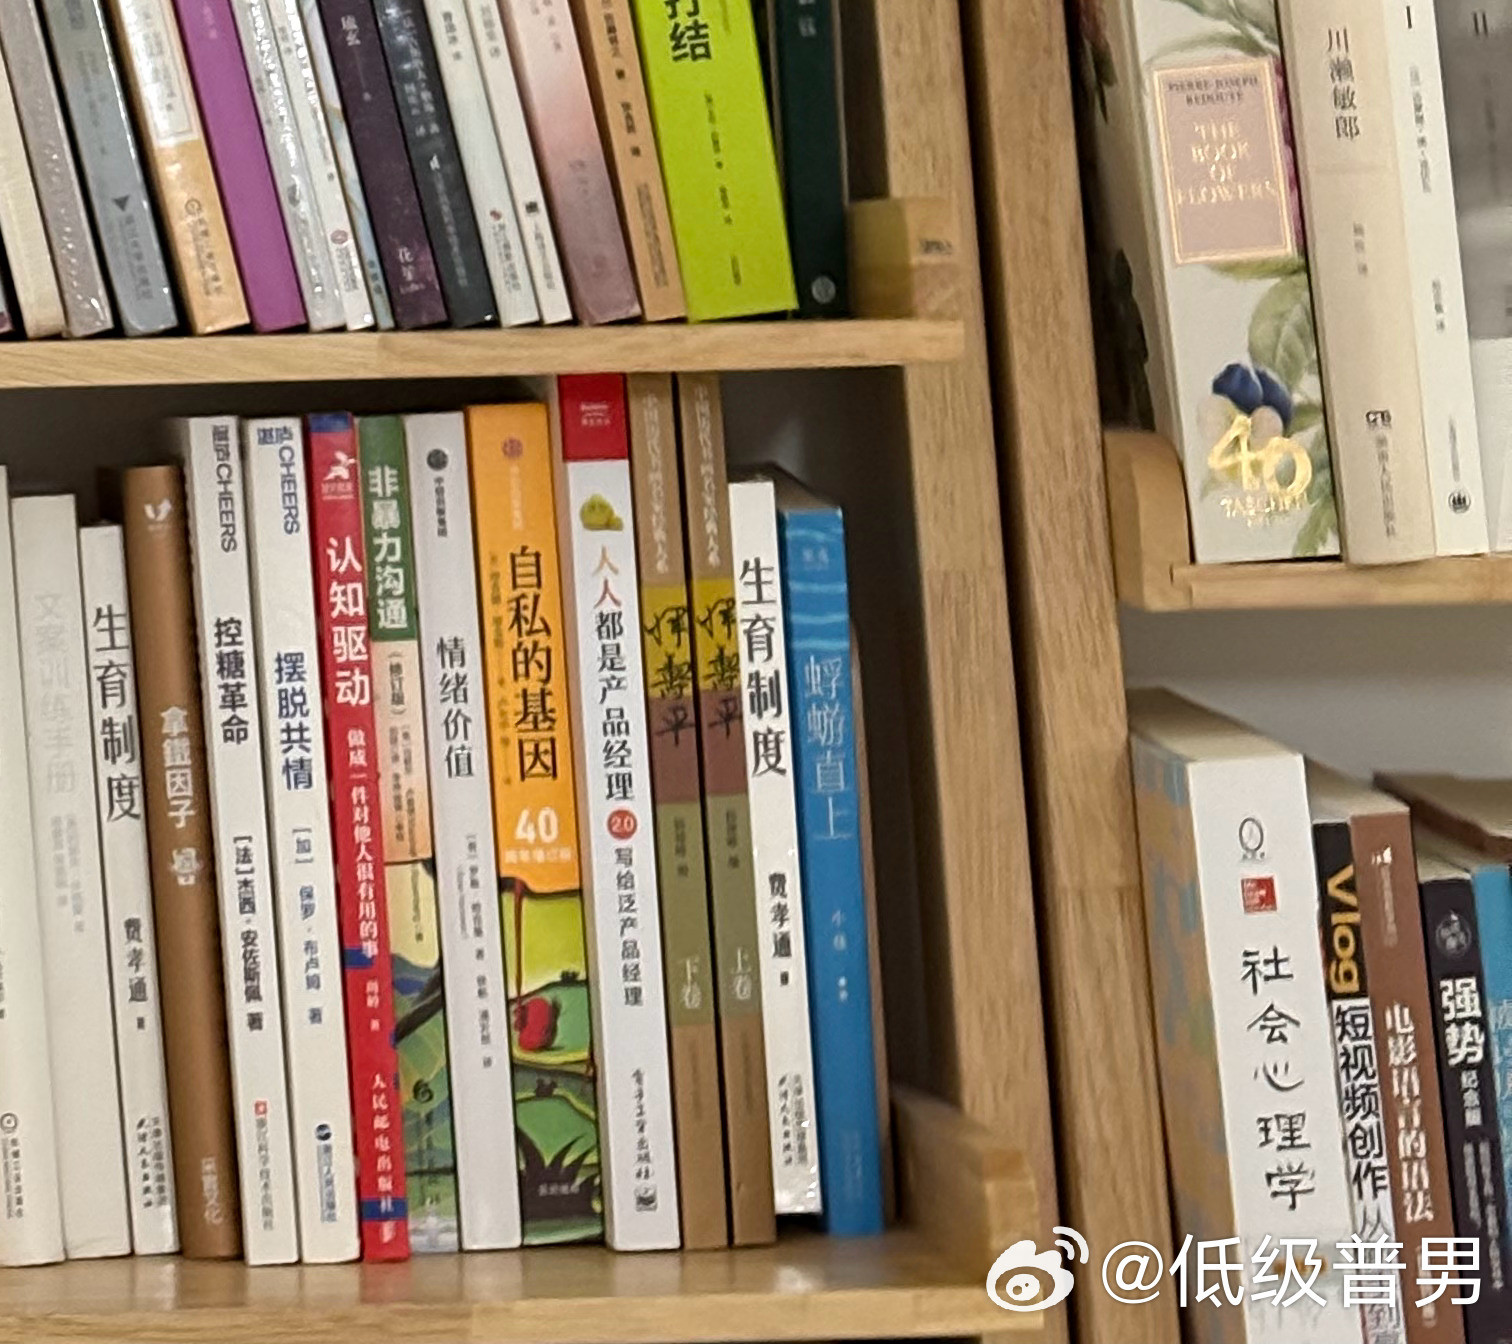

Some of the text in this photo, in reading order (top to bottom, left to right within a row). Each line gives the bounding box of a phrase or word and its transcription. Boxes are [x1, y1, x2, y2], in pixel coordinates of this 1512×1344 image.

[1194, 120, 1239, 141] THE
[1326, 27, 1362, 141] 川濑敏郎
[1176, 180, 1276, 206] FLOWERS
[1191, 141, 1250, 163] BOOK
[215, 463, 238, 553] CHEERS
[277, 446, 300, 536] CHEERS
[1207, 413, 1313, 500] 40
[367, 465, 409, 630] 非暴力沟通
[213, 616, 250, 746] 控糖革命
[326, 536, 371, 706] 认知驱动
[507, 545, 559, 783] 自私的基因
[593, 545, 636, 802] 人人都是产品经理
[739, 556, 787, 778] 生育制度
[33, 593, 79, 796] 文案训练手册
[91, 604, 142, 824] 生育制度
[274, 650, 314, 792] 摆脱共情
[436, 635, 475, 780] 情绪价值
[346, 728, 380, 959] 做成一件对他人很有用的事
[514, 807, 560, 843] 40
[123, 916, 149, 1004] 费孝通
[613, 846, 644, 1008] 写给泛产品经理
[730, 947, 752, 1001] 上卷
[768, 872, 792, 959] 费孝通
[1326, 864, 1362, 995] Vlog
[679, 958, 703, 1010] 下卷
[1439, 976, 1486, 1068] 强势
[1239, 945, 1318, 1211] 社会心理学
[1334, 1002, 1390, 1201] 短视频创作
